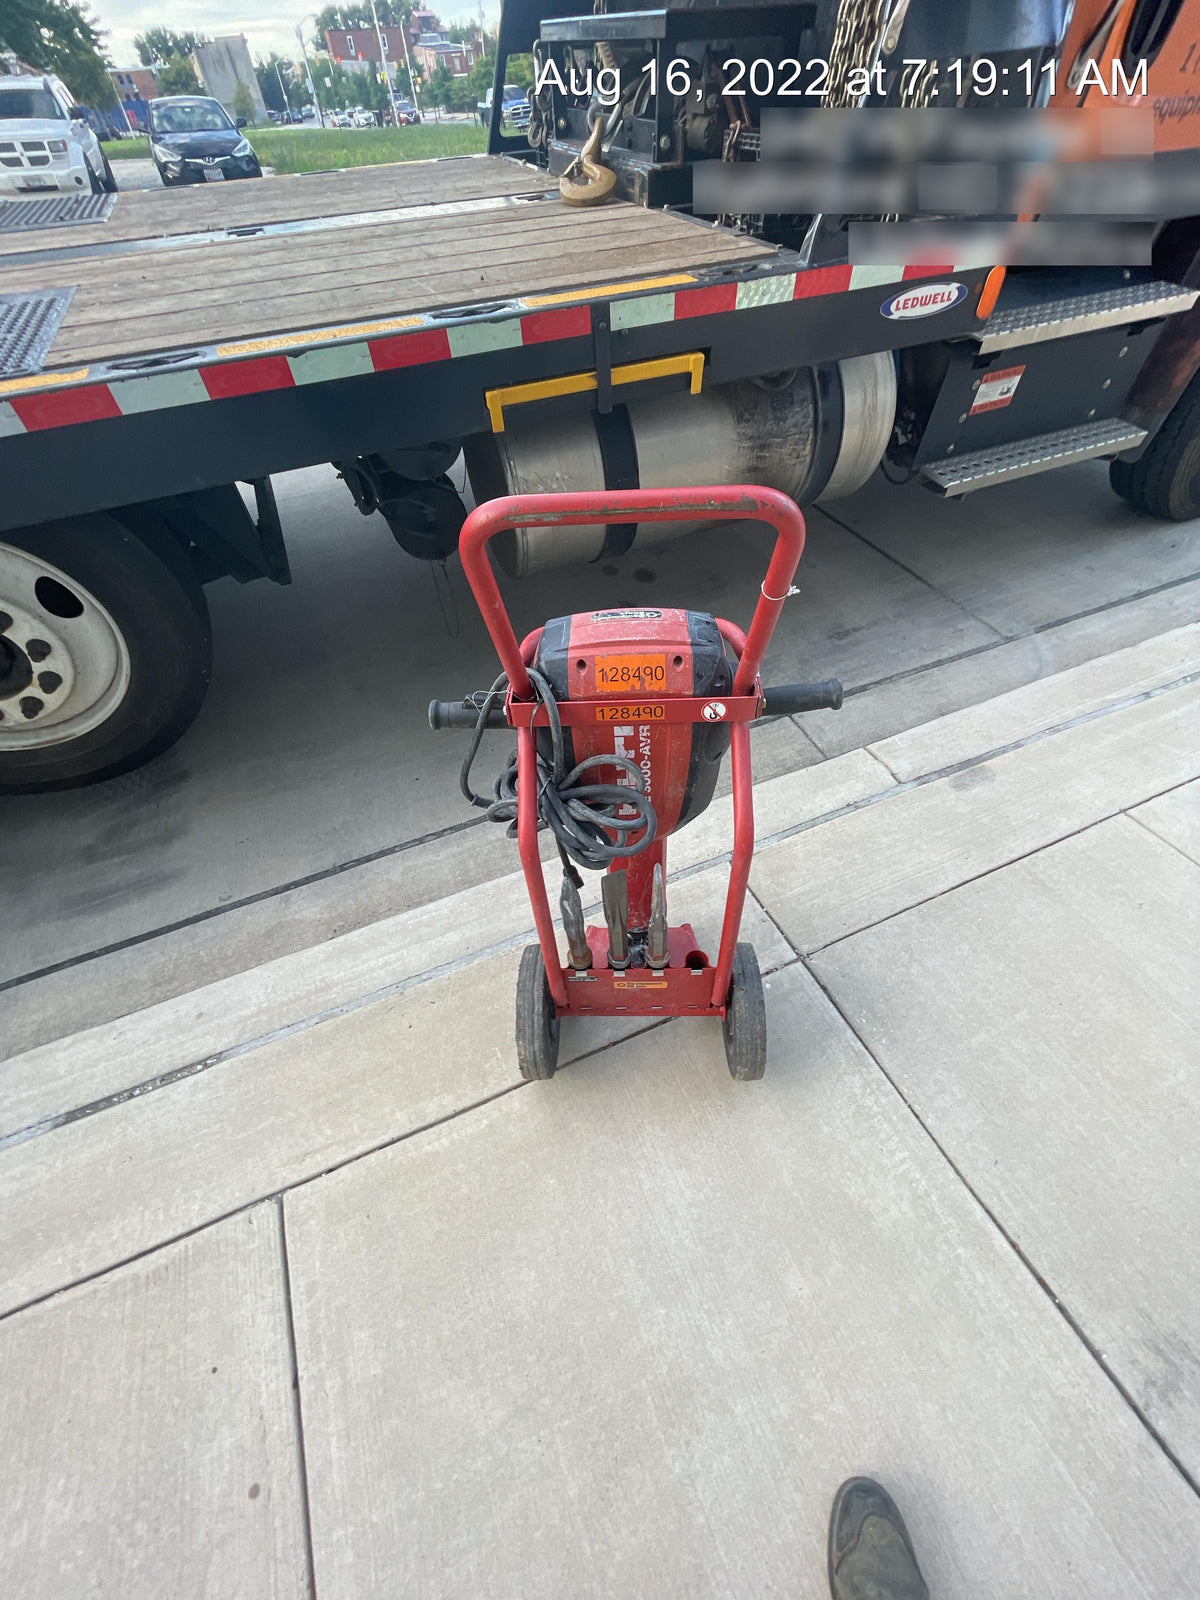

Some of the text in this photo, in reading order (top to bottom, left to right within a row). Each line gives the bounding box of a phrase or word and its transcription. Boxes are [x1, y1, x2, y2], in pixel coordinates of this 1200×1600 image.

[894, 290, 953, 312] LEDWELL
[598, 665, 665, 682] 128490
[598, 706, 664, 720] 128490
[613, 726, 636, 815] HLTI
